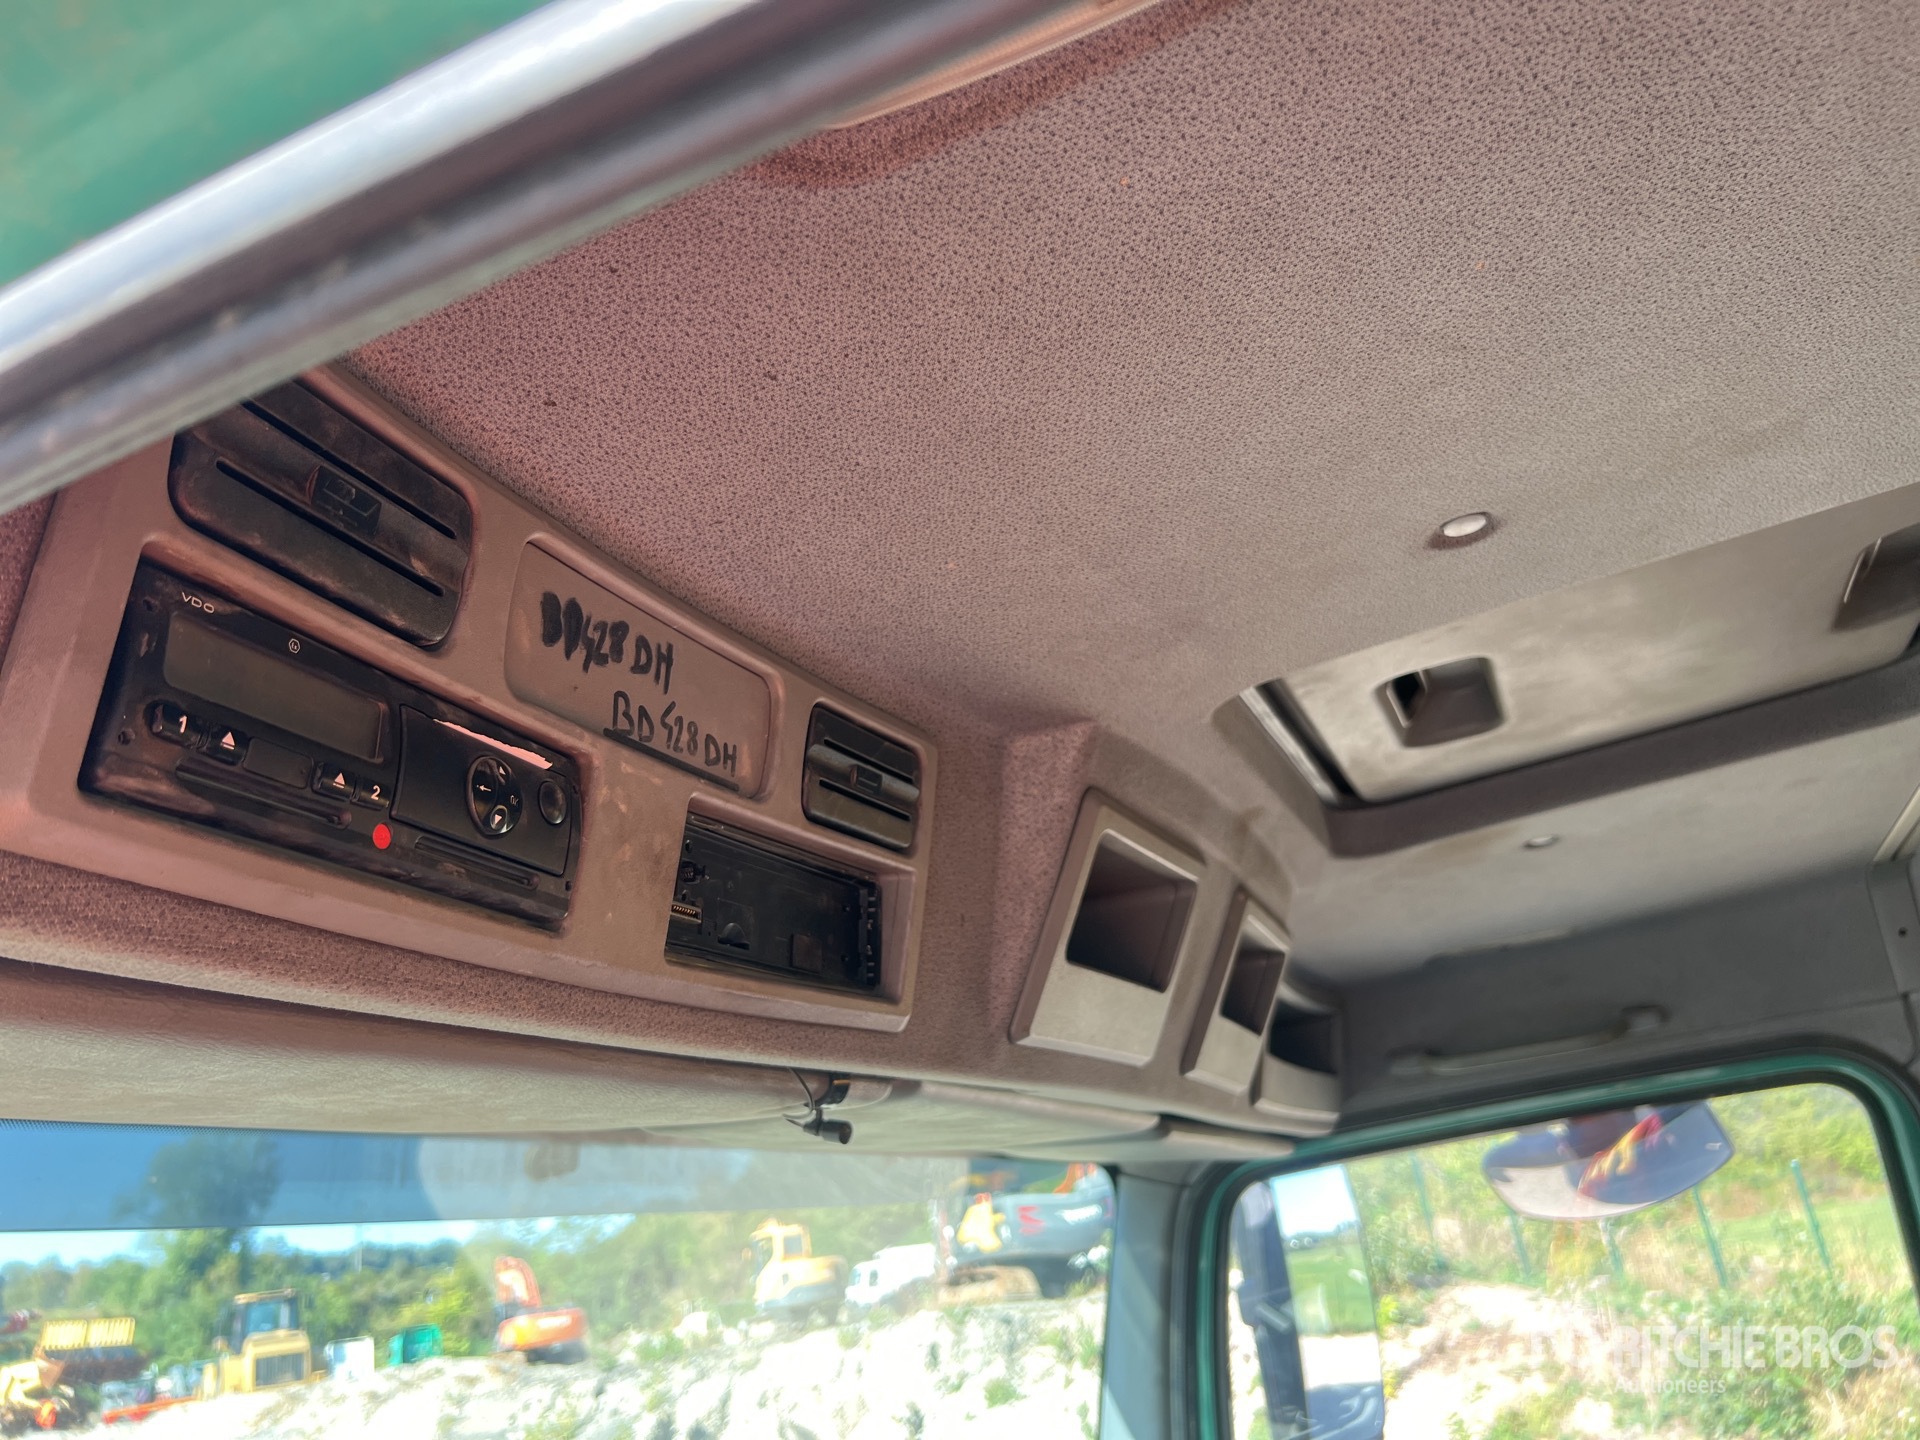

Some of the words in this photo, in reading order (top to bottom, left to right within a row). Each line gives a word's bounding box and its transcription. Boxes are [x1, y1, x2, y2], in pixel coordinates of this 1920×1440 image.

[181, 591, 215, 614] VDO
[179, 715, 188, 734] 1
[370, 784, 381, 801] 2
